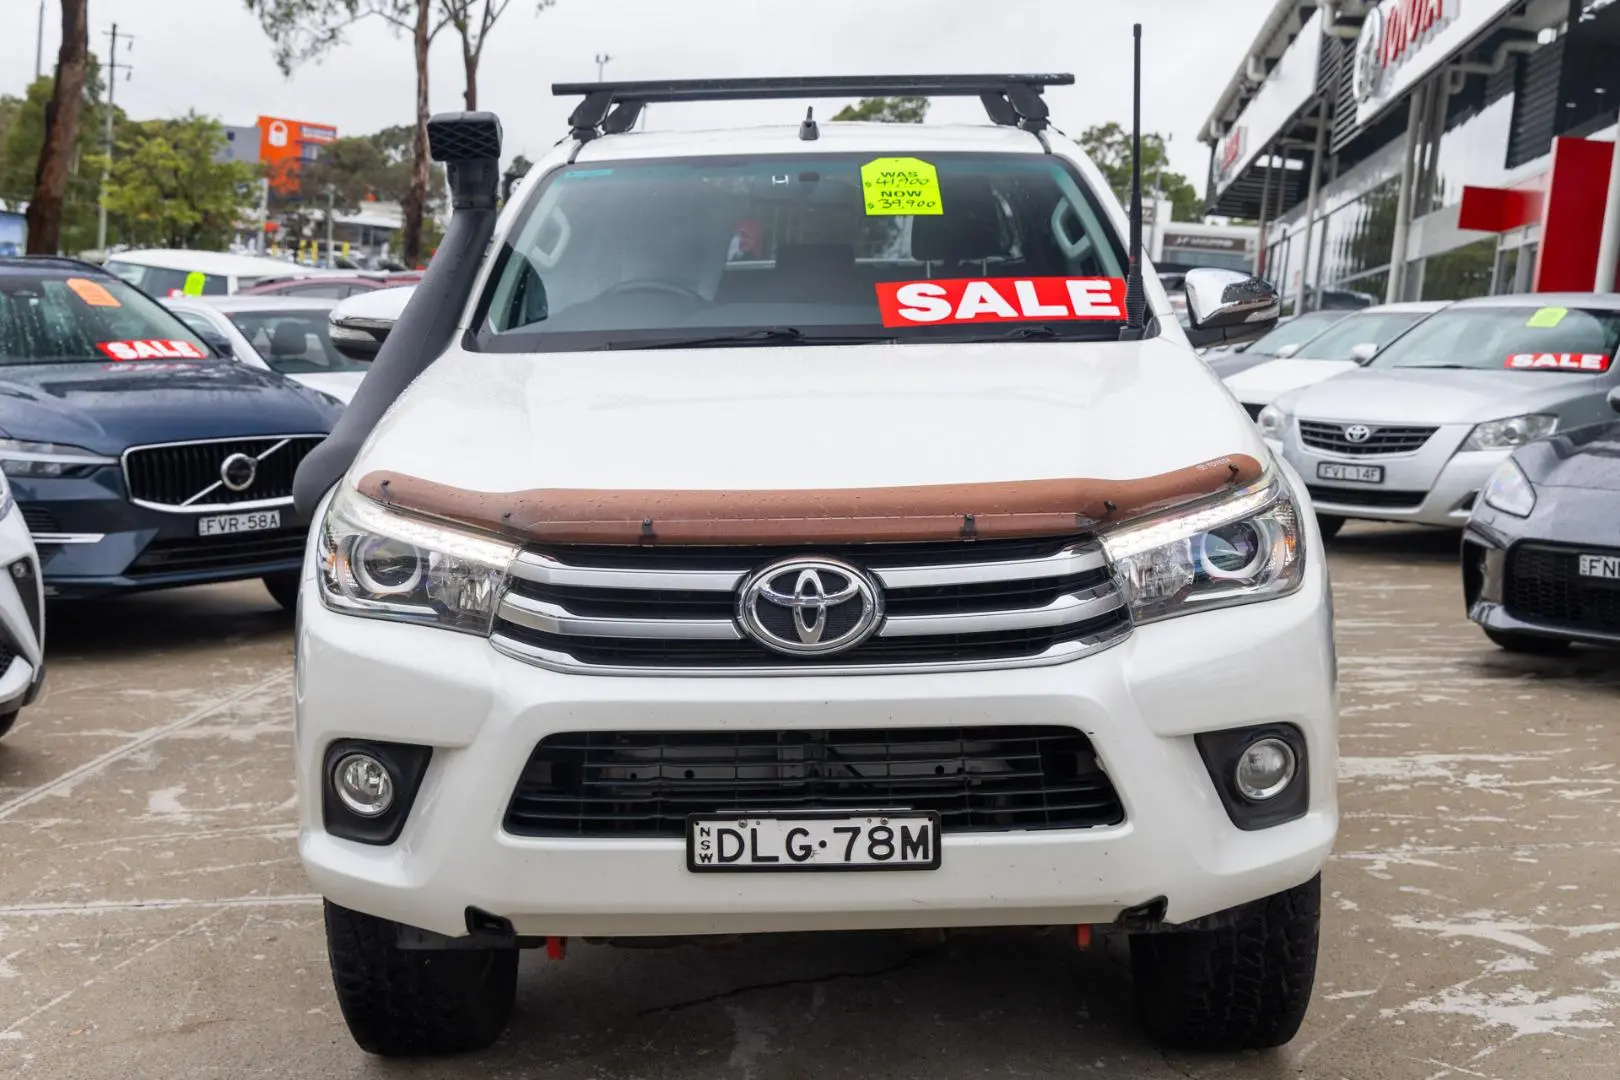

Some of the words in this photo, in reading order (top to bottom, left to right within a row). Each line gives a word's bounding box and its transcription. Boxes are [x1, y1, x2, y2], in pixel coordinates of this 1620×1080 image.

[881, 190, 922, 198] NOW
[896, 280, 1120, 322] SALE
[107, 340, 201, 360] SALE
[1511, 353, 1603, 369] SALE
